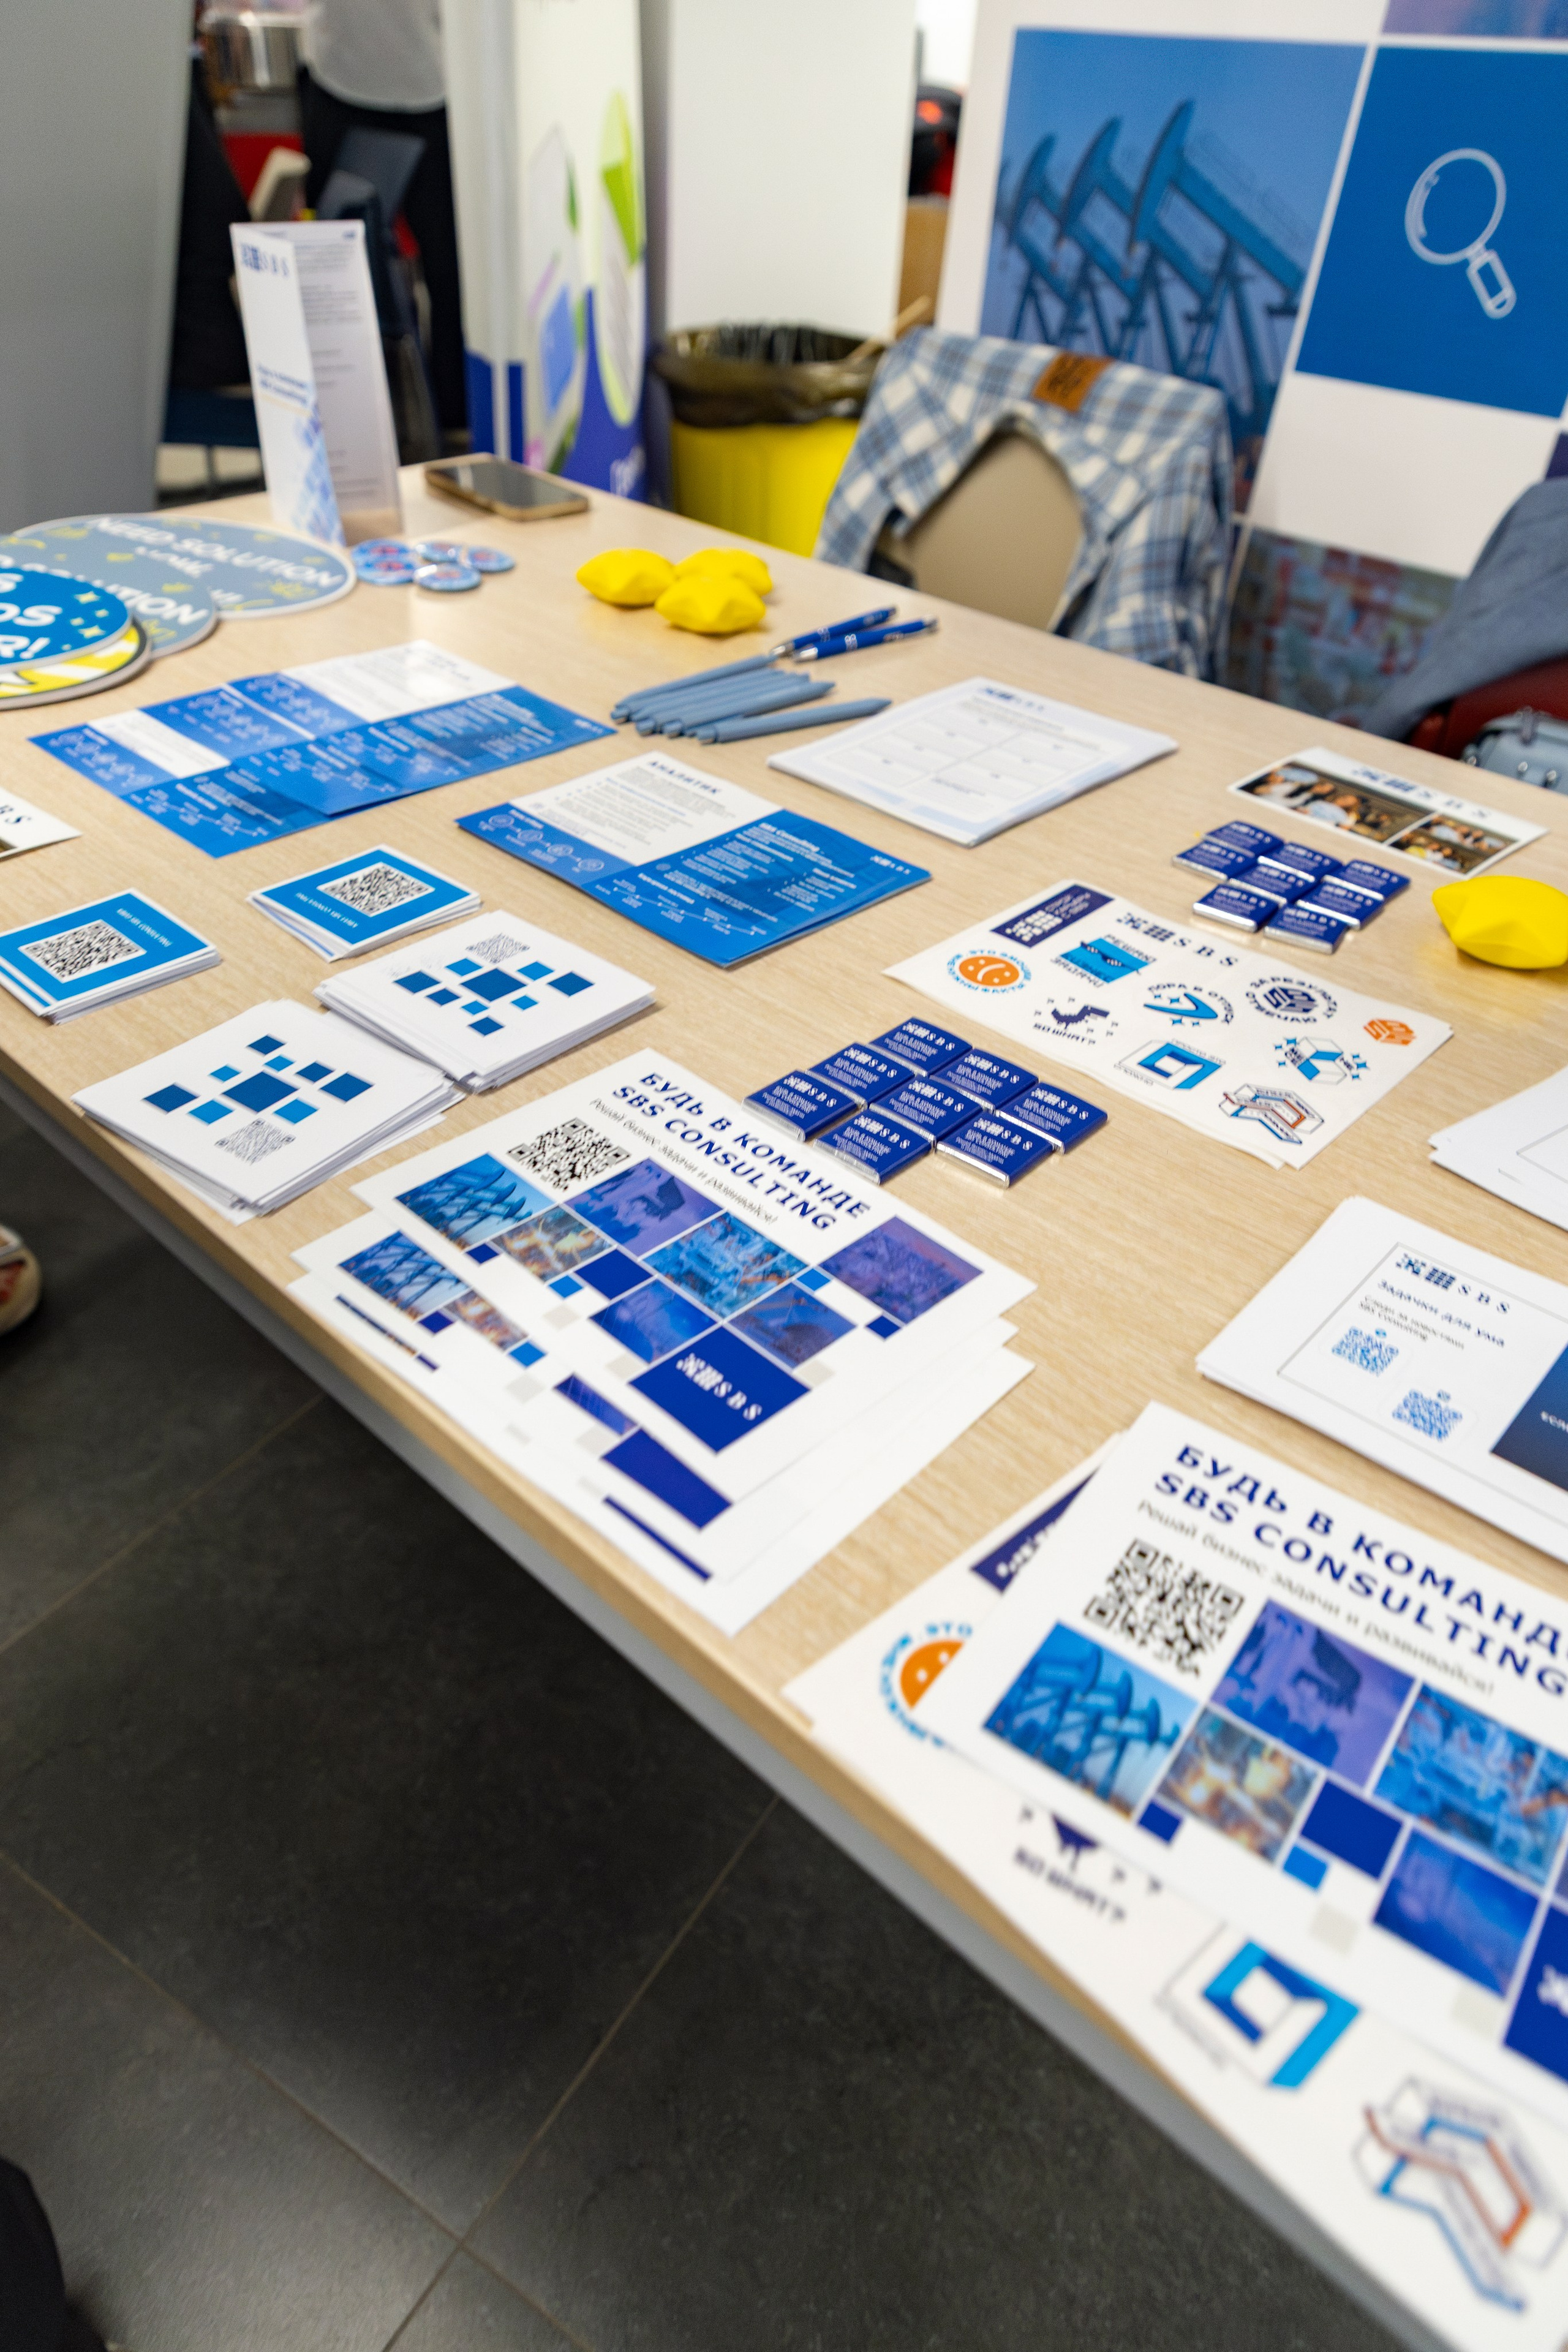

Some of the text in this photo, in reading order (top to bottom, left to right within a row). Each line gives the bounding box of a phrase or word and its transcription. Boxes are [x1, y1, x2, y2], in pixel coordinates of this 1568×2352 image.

[1174, 937, 1238, 967] SBS
[612, 1085, 665, 1117] SBS
[664, 1118, 837, 1231] CONSULTING
[639, 1072, 705, 1116] БУДЬ
[709, 1117, 733, 1131] В
[733, 1133, 871, 1219] КОМАНДЕ
[713, 1381, 763, 1421] SBS
[1137, 1499, 1197, 1539] Решай
[1202, 1532, 1266, 1577] бизнес
[1154, 1472, 1568, 1696] SBS CONSULTING
[1175, 1444, 1568, 1660] БУДЬ В КОМАНД
